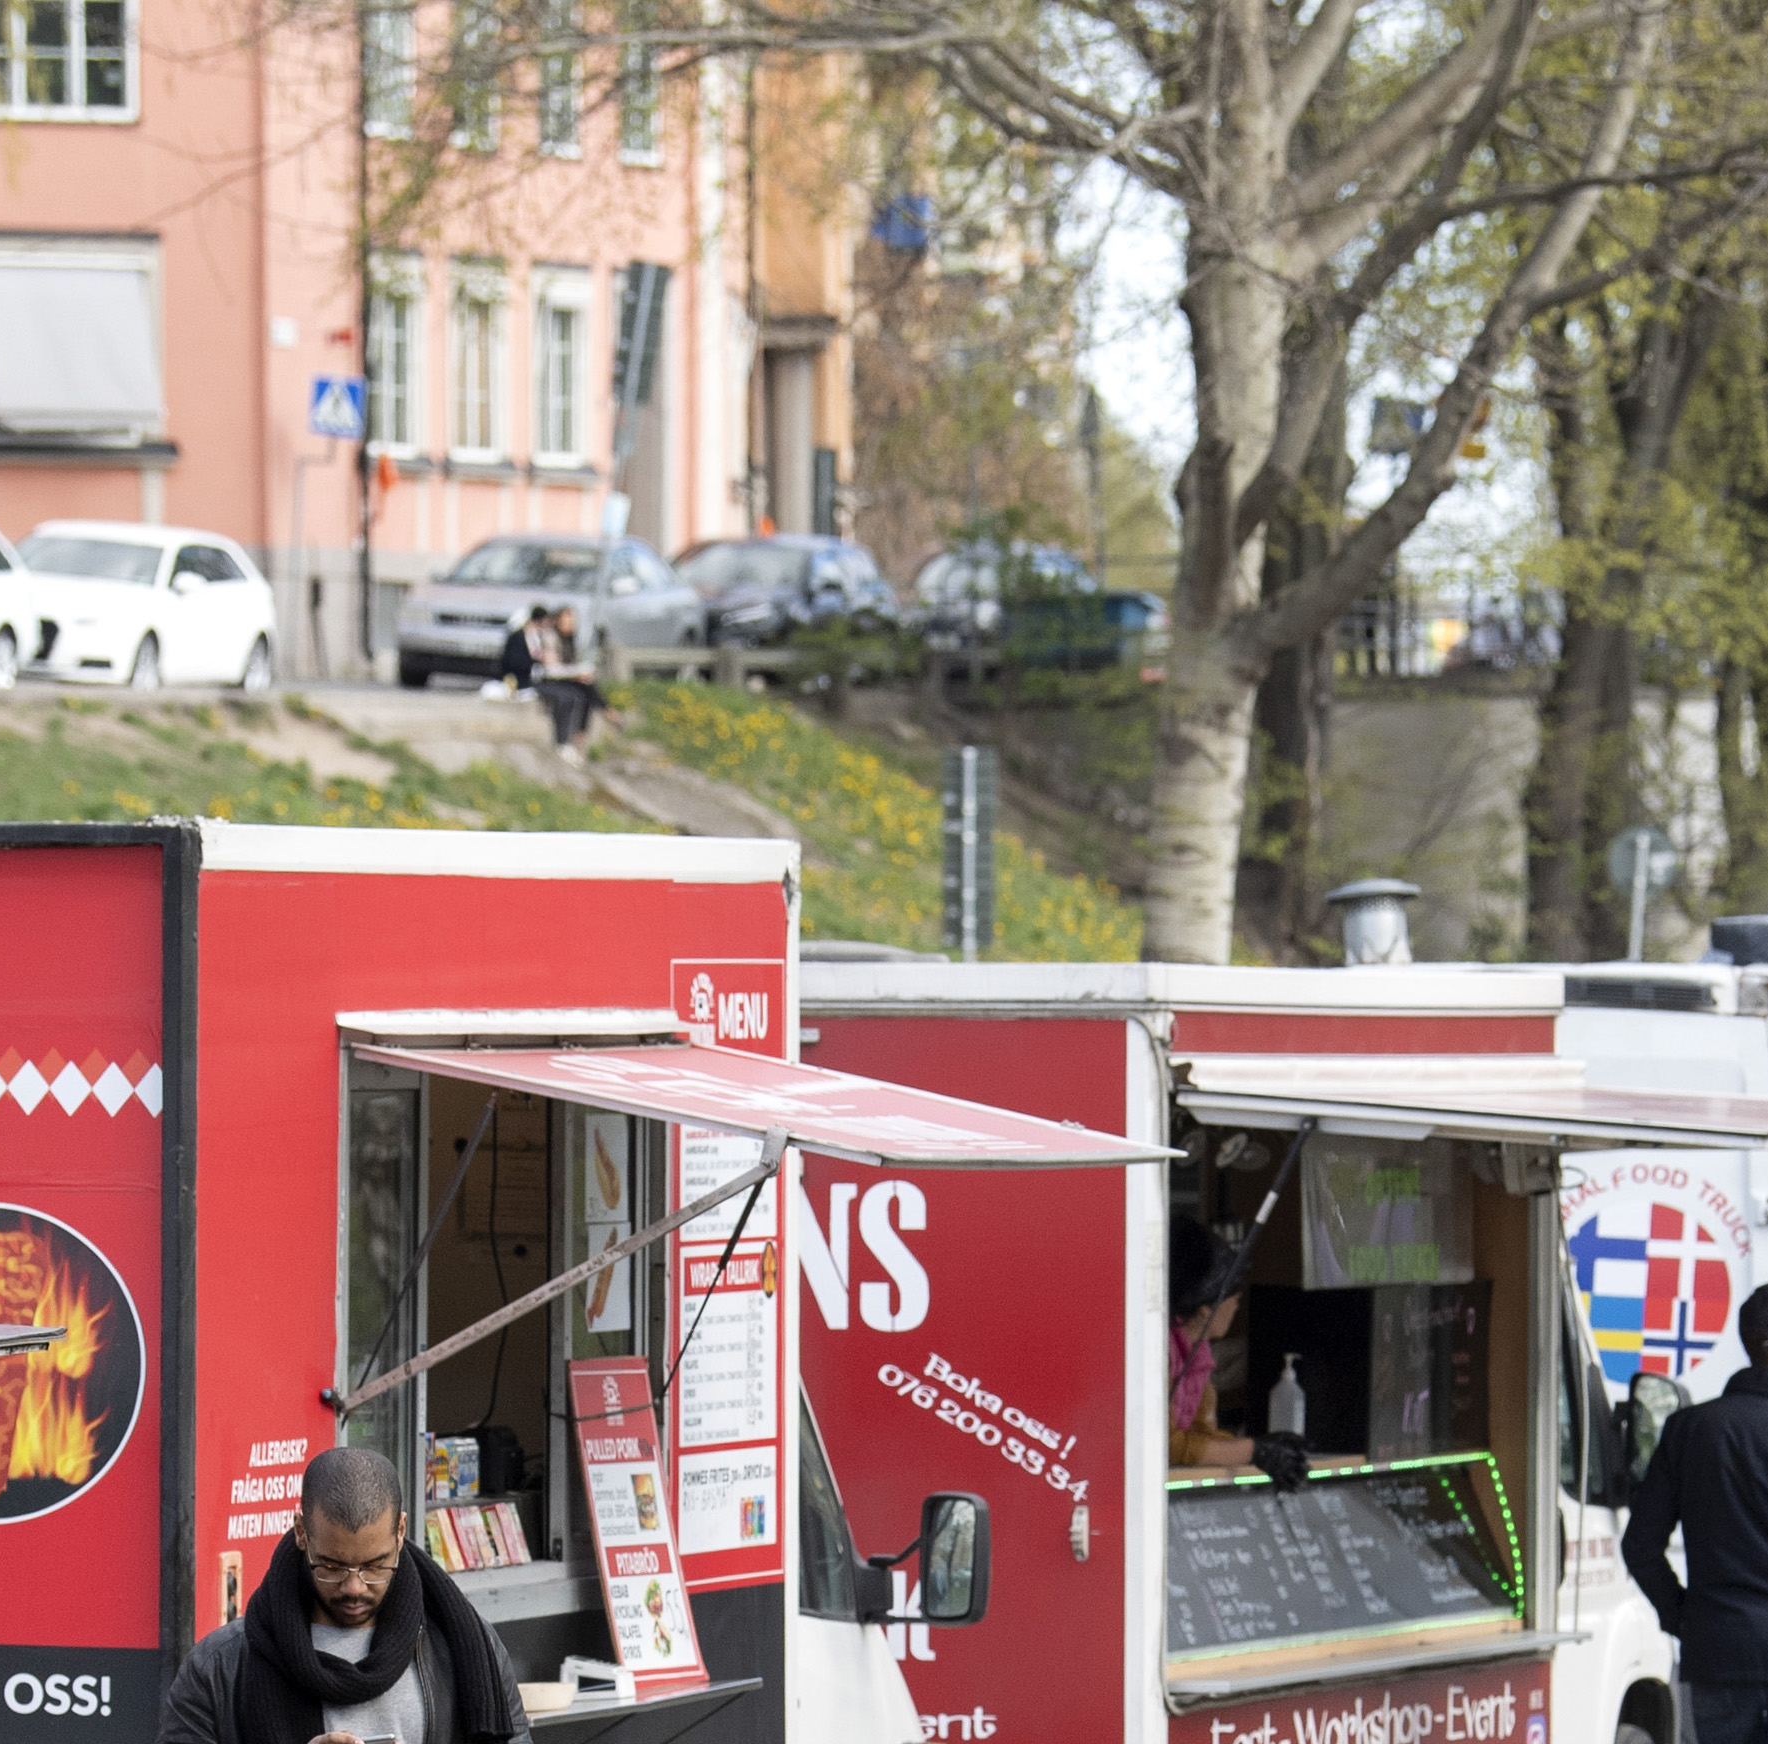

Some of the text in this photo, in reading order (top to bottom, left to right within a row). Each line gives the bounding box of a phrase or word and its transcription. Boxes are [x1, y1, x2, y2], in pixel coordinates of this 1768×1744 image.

[718, 992, 768, 1040] MENU
[1612, 1163, 1688, 1190] FOOD
[923, 1351, 1002, 1415] Boka
[877, 1363, 939, 1410] 076
[935, 1398, 1002, 1447] 200
[1000, 1437, 1047, 1476] 33
[249, 1438, 308, 1467] ALLERGISK?
[585, 1438, 616, 1461] PULLED
[231, 1474, 263, 1504] FRÅGA
[264, 1475, 285, 1500] OSS
[227, 1514, 261, 1540] MATEN
[4, 1673, 112, 1717] OSS!
